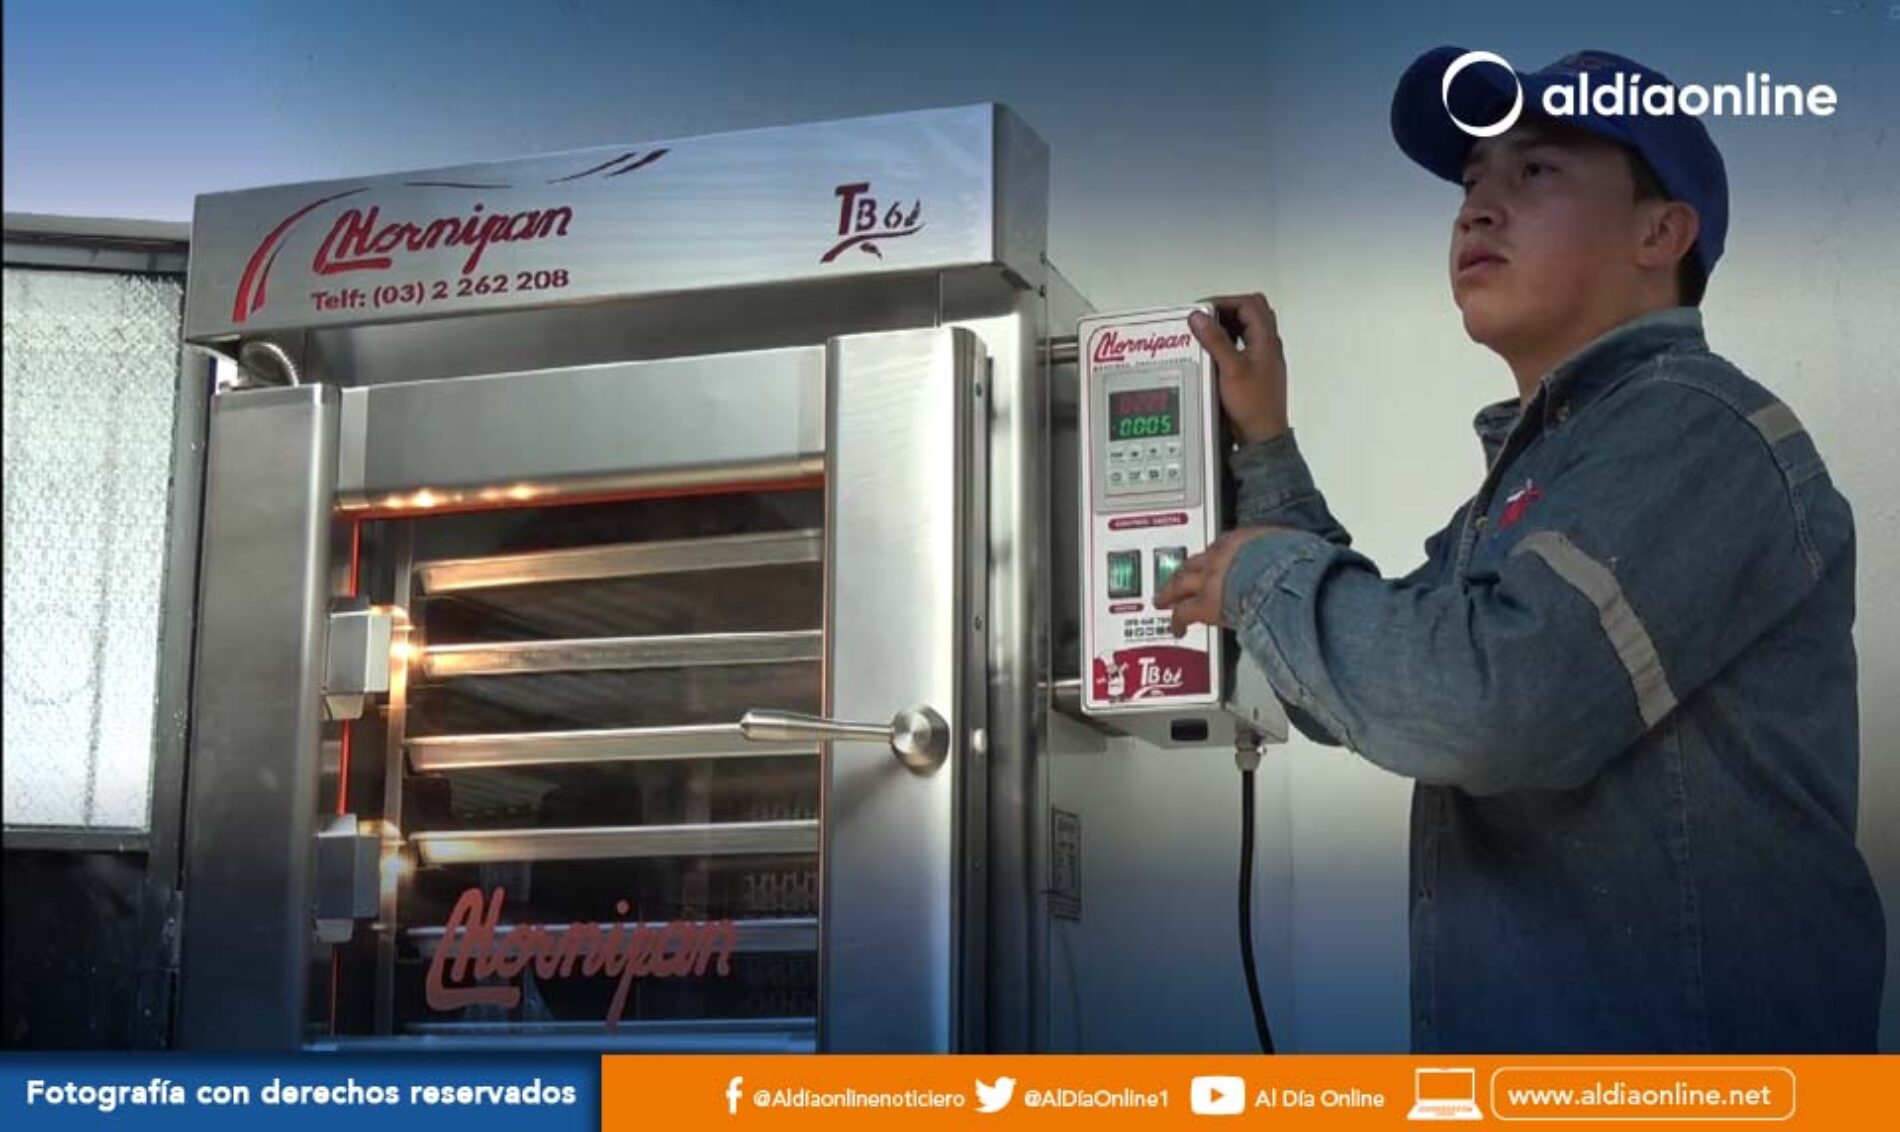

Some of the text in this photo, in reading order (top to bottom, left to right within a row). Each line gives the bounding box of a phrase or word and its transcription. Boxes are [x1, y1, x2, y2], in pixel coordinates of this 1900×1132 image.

[313, 203, 573, 275] Hornipan
[312, 269, 570, 311] Telf: (03) 2 262 208
[1093, 332, 1191, 363] Hornipan
[426, 887, 737, 1031] Hornipan
